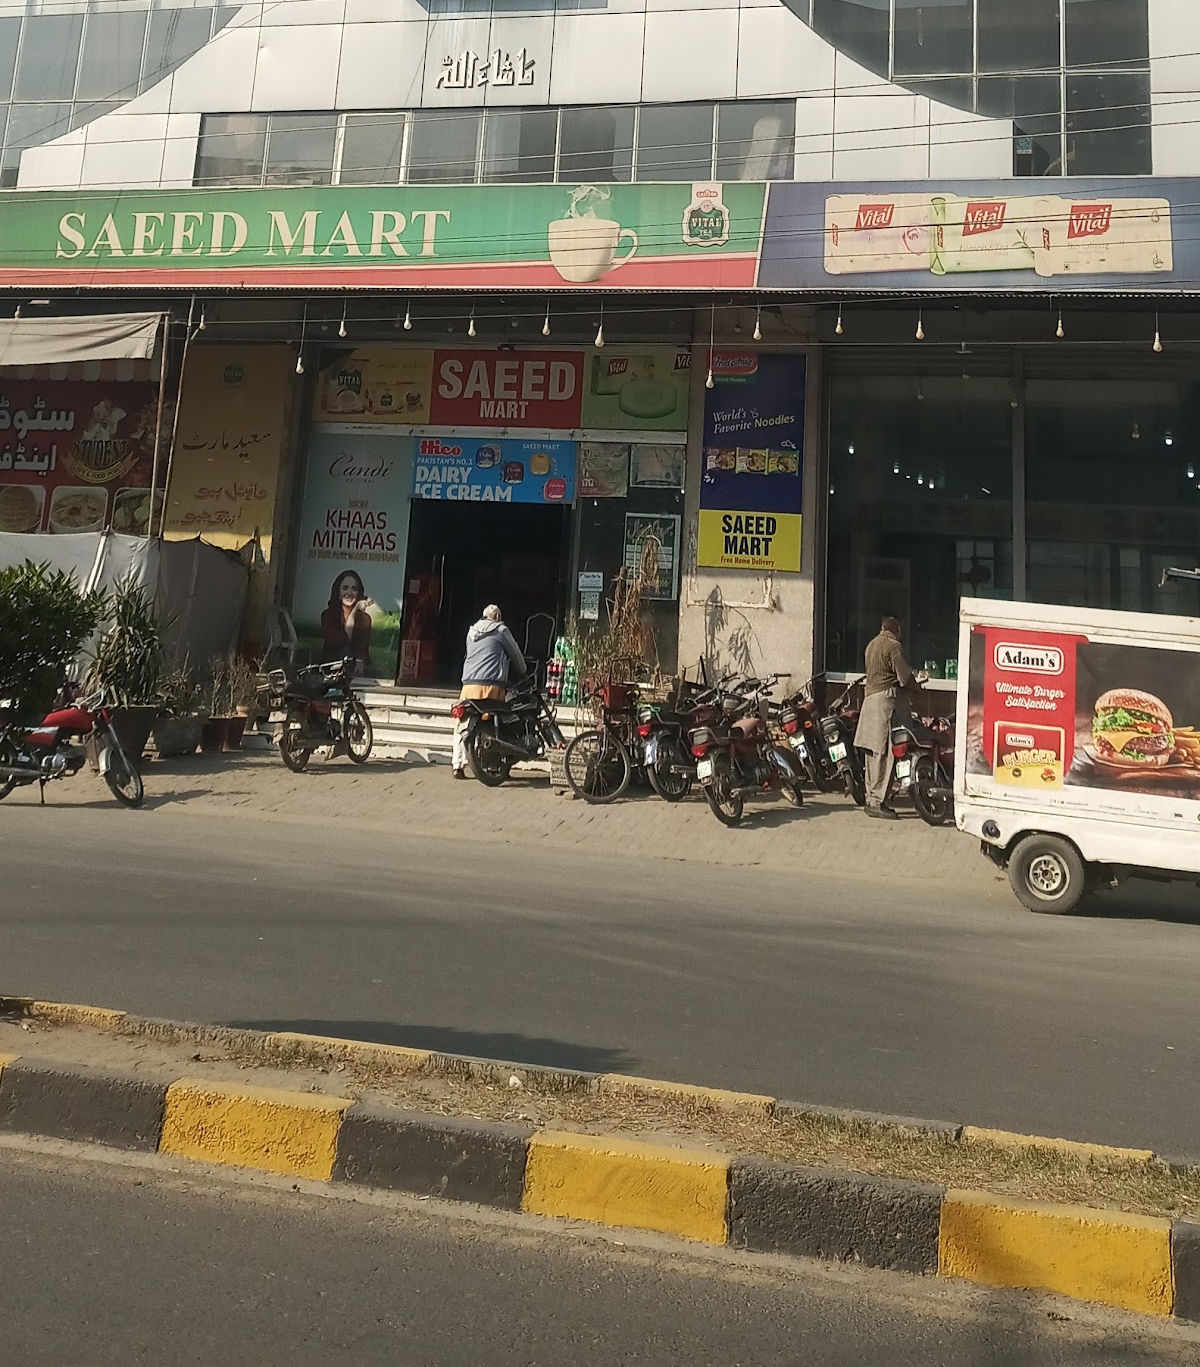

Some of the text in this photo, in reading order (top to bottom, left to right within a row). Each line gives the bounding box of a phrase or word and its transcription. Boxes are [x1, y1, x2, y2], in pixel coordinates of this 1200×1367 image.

[691, 217, 722, 227] VITAL
[858, 205, 894, 228] Vital
[966, 205, 1004, 231] Vital
[1070, 205, 1111, 234] Vital
[56, 210, 452, 259] SAEED MART
[609, 360, 627, 374] Vital
[338, 375, 361, 385] VITAL
[438, 358, 576, 401] SAEED
[479, 400, 528, 419] MART
[712, 408, 747, 423] World's
[713, 414, 795, 434] Favorite Noodles
[72, 439, 129, 468] STUDENT
[543, 443, 560, 451] MART
[328, 452, 394, 477] Candi
[416, 457, 456, 466] PAKISTAN'S
[415, 466, 473, 484] DAIRY
[414, 483, 513, 502] ICE CREAM
[325, 509, 388, 530] KHAAS
[721, 514, 777, 536] SAEED
[312, 530, 397, 551] MITHAAS
[724, 535, 773, 556] MART
[720, 556, 775, 567] Free Home Delivery
[1001, 650, 1056, 669] Adam's
[995, 682, 1066, 700] Ultimate Burger
[1005, 696, 1058, 711] Satisfaction
[1009, 737, 1031, 745] Adam's
[1002, 749, 1057, 769] BURGER
